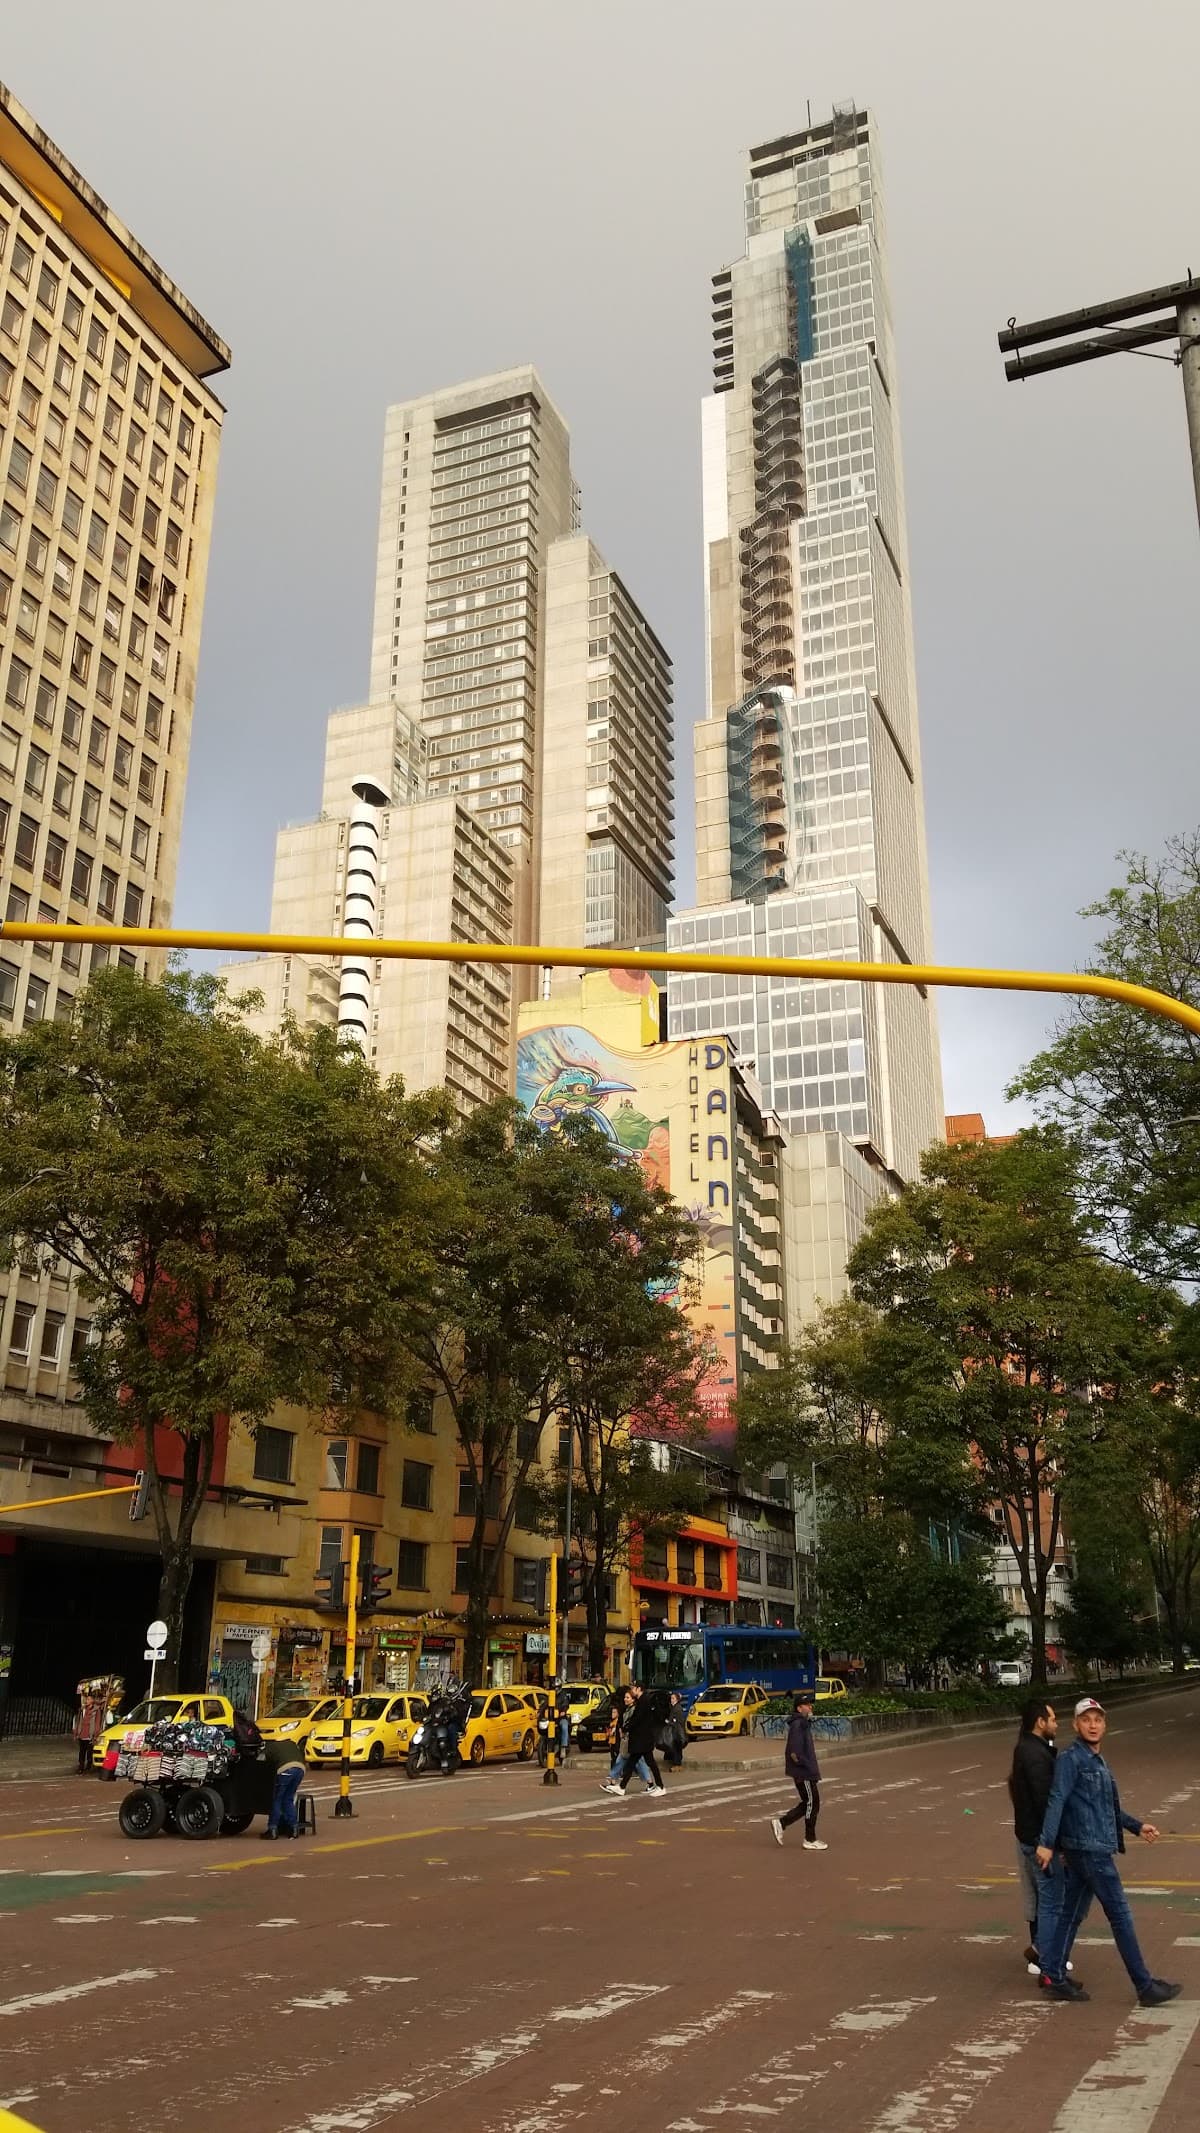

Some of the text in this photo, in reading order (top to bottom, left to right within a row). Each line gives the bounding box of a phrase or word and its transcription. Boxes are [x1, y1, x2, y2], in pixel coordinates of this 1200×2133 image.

[688, 1047, 699, 1182] HOTEL
[226, 1627, 270, 1635] INTERNET
[646, 1632, 660, 1641] 257
